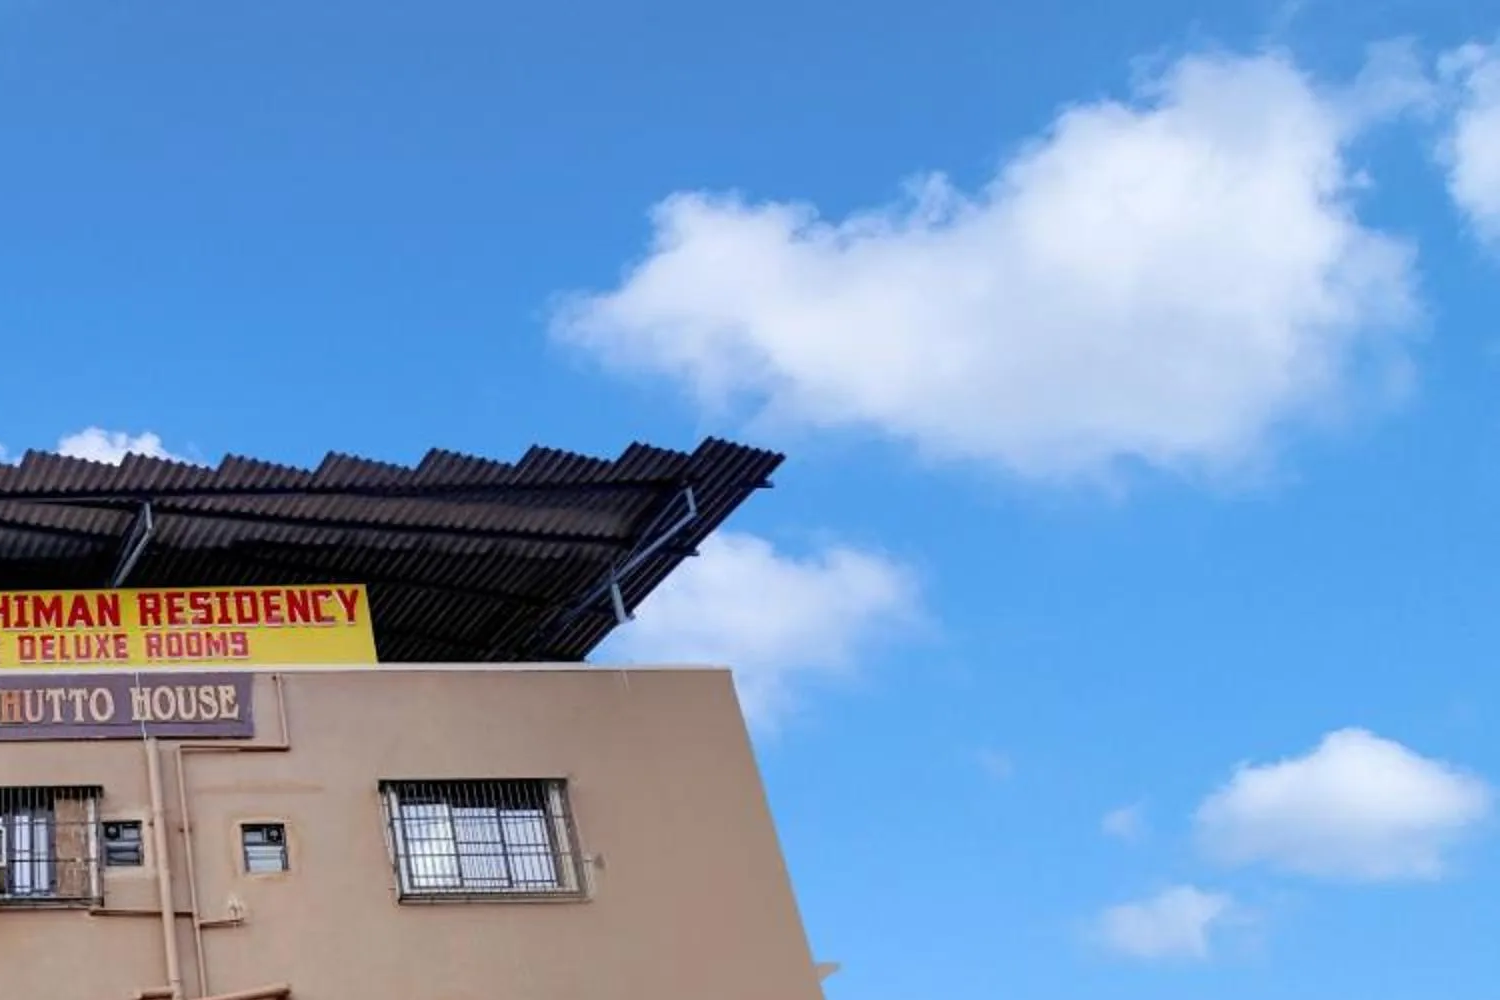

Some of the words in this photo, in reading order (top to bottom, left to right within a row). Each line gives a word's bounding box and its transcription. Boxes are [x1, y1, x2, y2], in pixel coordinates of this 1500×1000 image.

[137, 588, 360, 628] RESIDENCY
[17, 632, 129, 662] DELUXE
[145, 631, 250, 661] ROOMS
[130, 685, 240, 721] HOUSE
